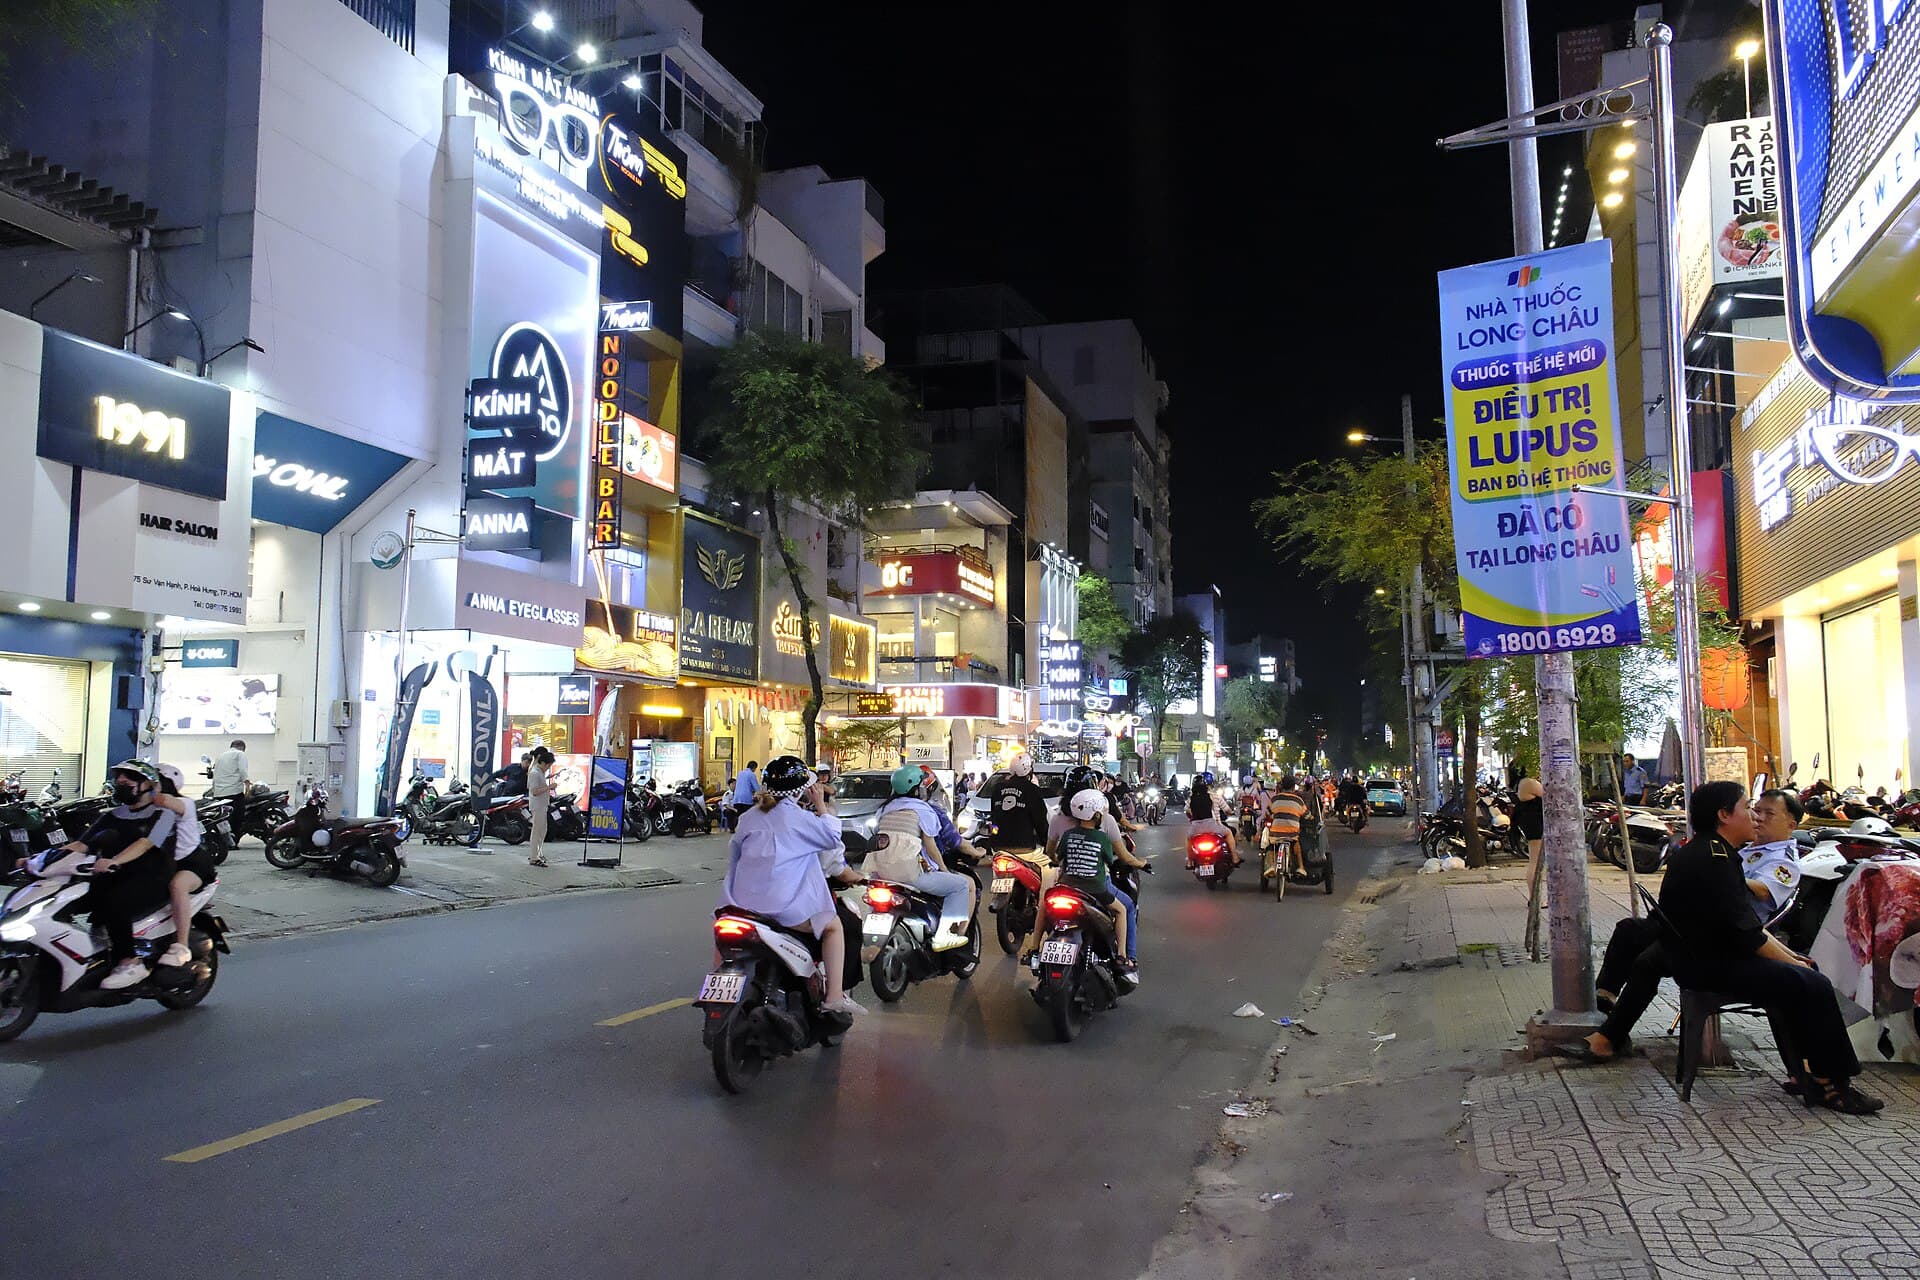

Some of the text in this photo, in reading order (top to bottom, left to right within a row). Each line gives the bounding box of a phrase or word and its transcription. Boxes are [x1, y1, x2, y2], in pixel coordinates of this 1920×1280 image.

[488, 48, 526, 81] KÍNH
[565, 87, 600, 115] ANNA
[1730, 125, 1756, 215] RAMEN
[1466, 282, 1582, 321] NHÀ THUỐC
[1457, 306, 1599, 350] LONG CHÂU
[1457, 345, 1596, 383] THUỐC THẾ HỆ MỚI
[473, 389, 531, 417] KÍNH
[600, 335, 620, 467] NOODLE
[1474, 382, 1591, 424] ĐIỀU TRỊ
[96, 395, 186, 460] 1991
[1468, 419, 1599, 468] LUPUS
[473, 446, 526, 477] MẮT
[1468, 458, 1612, 493] BAN ĐỎ HỆ THỐNG
[140, 512, 218, 540] HAIR SALON
[468, 512, 529, 535] ANNA
[597, 478, 614, 542] BAR
[1497, 497, 1582, 538] ĐÃ CÓ
[1466, 532, 1620, 572] TẠI LONG CHÂU
[133, 575, 141, 583] 75
[882, 561, 913, 588] ỐC
[470, 592, 580, 627] ANNA EYEGLASSES
[708, 614, 754, 647] RELAX
[1497, 624, 1616, 653] 1800 6928
[1050, 664, 1080, 682] KÍNH
[1050, 688, 1081, 701] HMK
[590, 815, 619, 830] 100%
[1047, 942, 1073, 953] 59-F2
[702, 988, 738, 1000] 273.14
[710, 976, 738, 987] 81-H1
